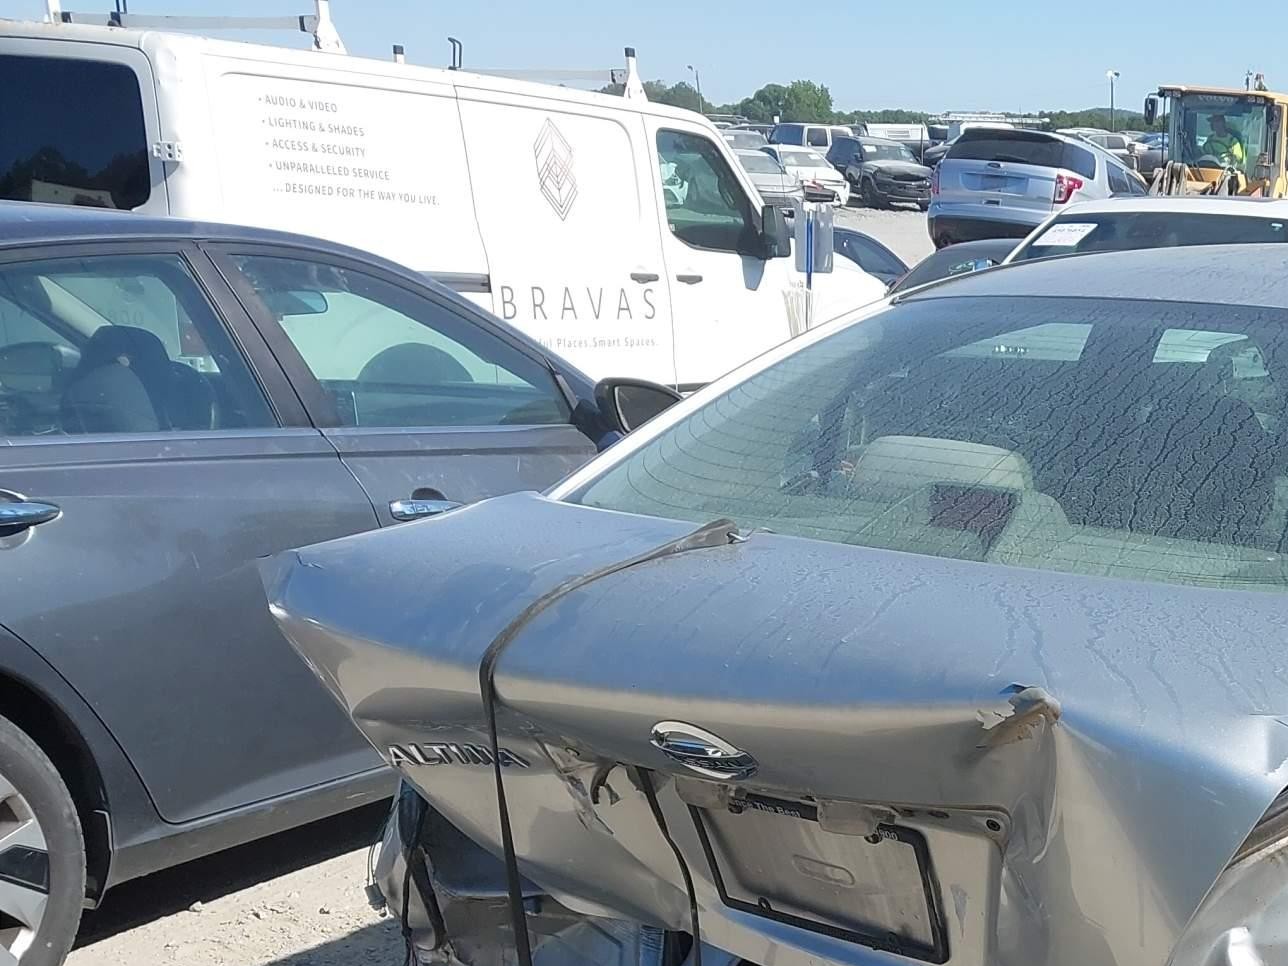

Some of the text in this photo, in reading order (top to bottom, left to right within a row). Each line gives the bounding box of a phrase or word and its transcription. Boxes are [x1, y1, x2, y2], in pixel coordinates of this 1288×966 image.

[265, 94, 338, 113] AUDIO & VIDEO
[268, 117, 365, 137] LIGHTING & SHADES
[272, 138, 366, 157] ACCESS & SECURITY
[275, 161, 390, 181] UNPARALLELED SERVICE
[336, 186, 355, 198] FOR
[358, 188, 375, 200] THE
[378, 190, 396, 202] WAY
[398, 192, 416, 204] YOU
[419, 194, 440, 206] LIVE.
[500, 285, 656, 320] BRAVAS
[388, 742, 531, 768] ALTIMA
[754, 801, 775, 814] The
[776, 806, 801, 818] Best
